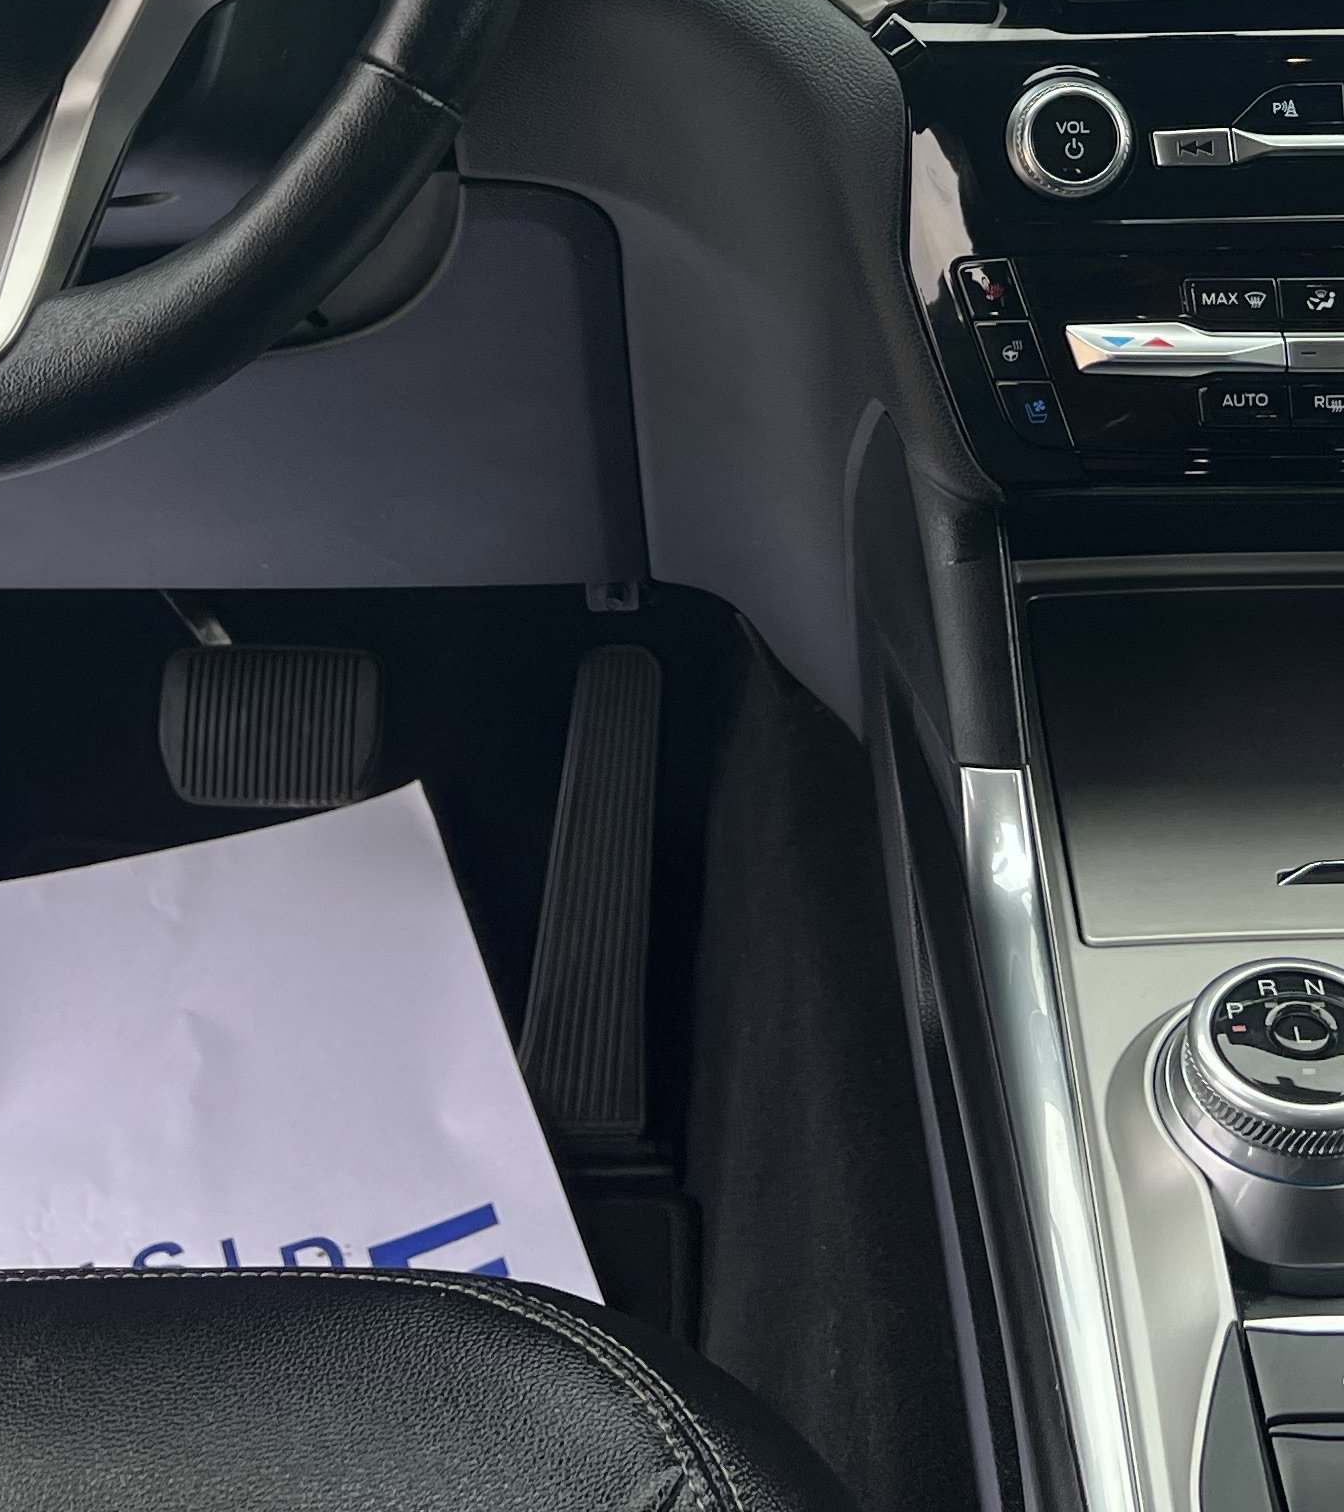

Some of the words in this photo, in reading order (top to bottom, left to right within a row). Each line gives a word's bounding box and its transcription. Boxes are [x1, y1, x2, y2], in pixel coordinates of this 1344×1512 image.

[1056, 121, 1090, 135] VOL
[1201, 292, 1239, 306] MAX
[1222, 393, 1269, 408] AUTO
[1225, 1001, 1244, 1020] P
[1257, 979, 1278, 996] R
[1304, 979, 1325, 995] N
[1293, 1026, 1312, 1044] L
